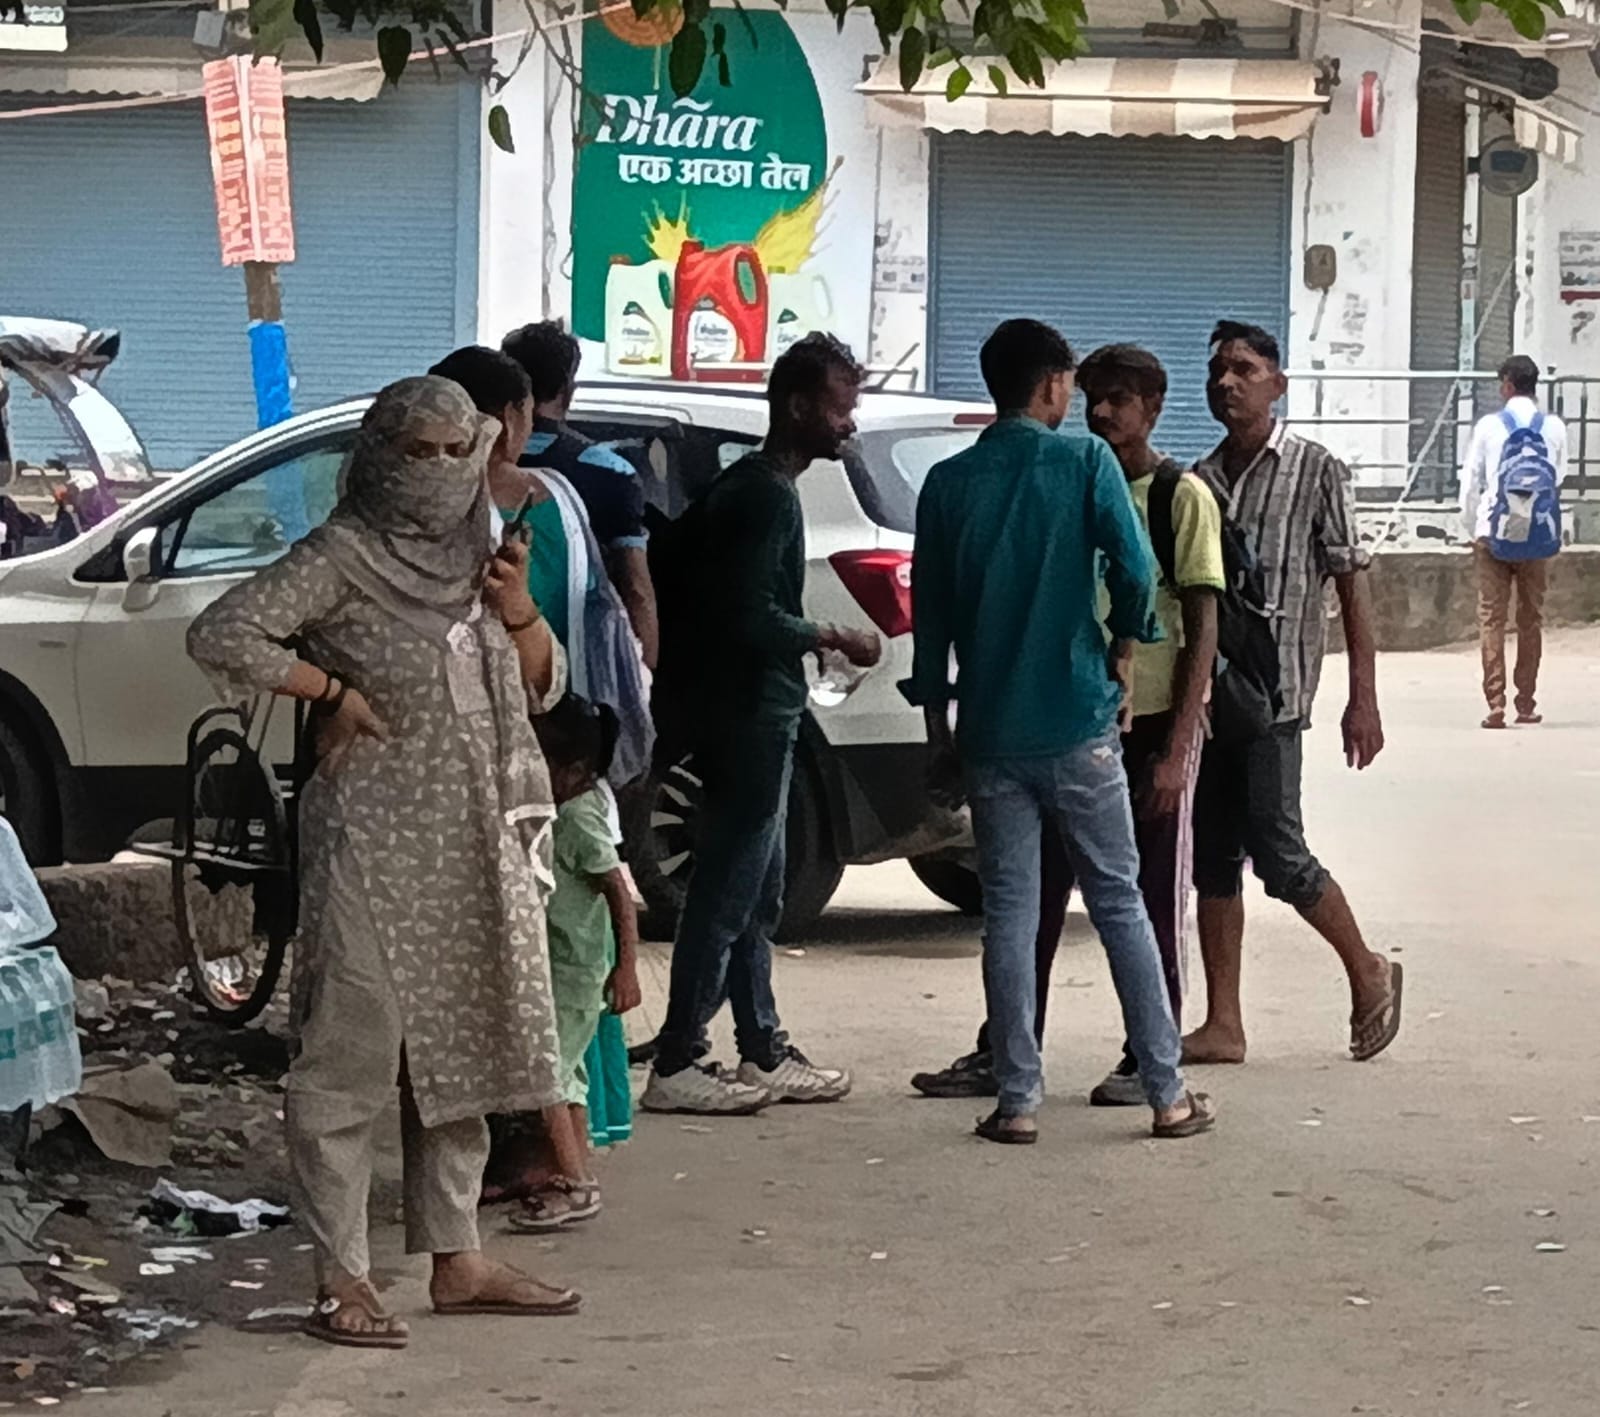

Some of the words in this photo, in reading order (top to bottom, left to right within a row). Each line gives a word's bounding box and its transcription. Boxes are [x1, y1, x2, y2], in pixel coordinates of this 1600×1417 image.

[618, 154, 673, 184] एक
[676, 158, 754, 188] अच्छा
[760, 152, 811, 191] तेल
